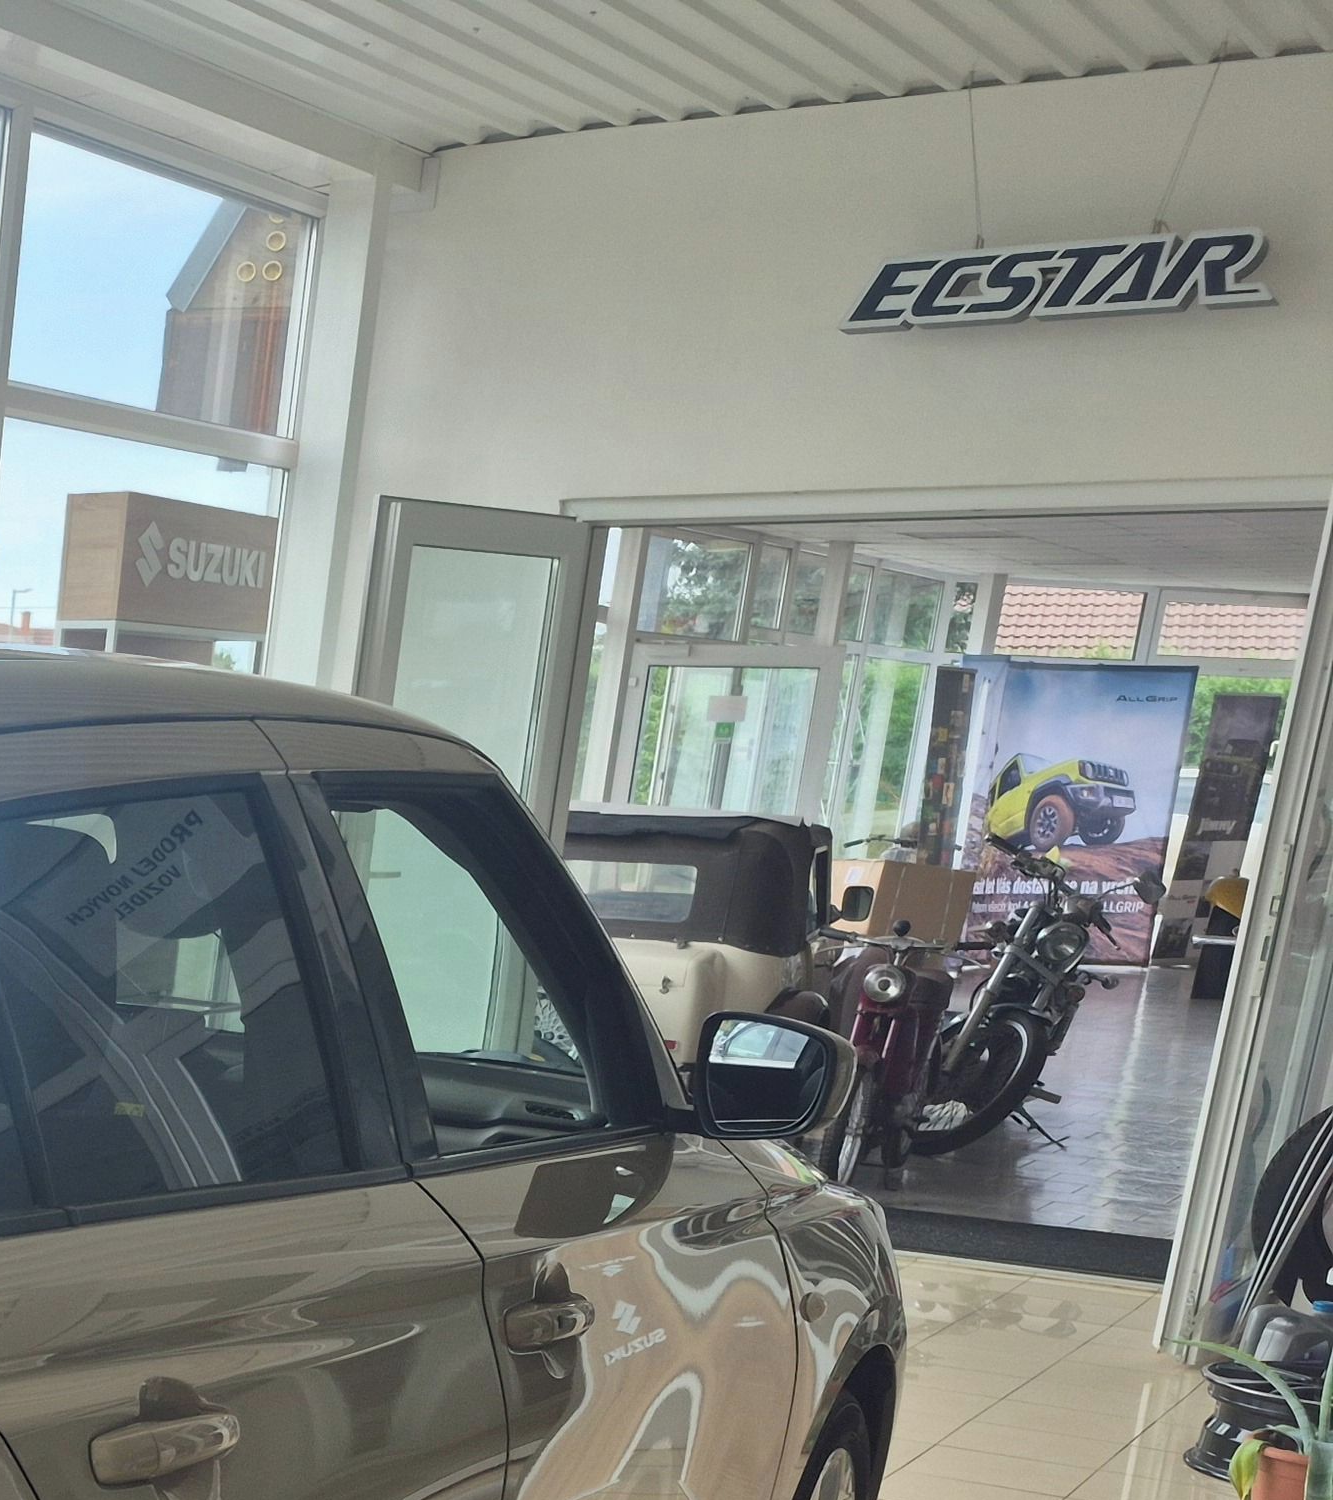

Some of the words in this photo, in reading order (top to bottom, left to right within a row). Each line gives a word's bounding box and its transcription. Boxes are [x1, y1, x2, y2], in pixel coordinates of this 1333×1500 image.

[843, 228, 1275, 329] ECSTAR
[167, 537, 267, 589] SUZUKI
[1080, 880, 1098, 894] na
[1102, 901, 1144, 913] LLGRIP
